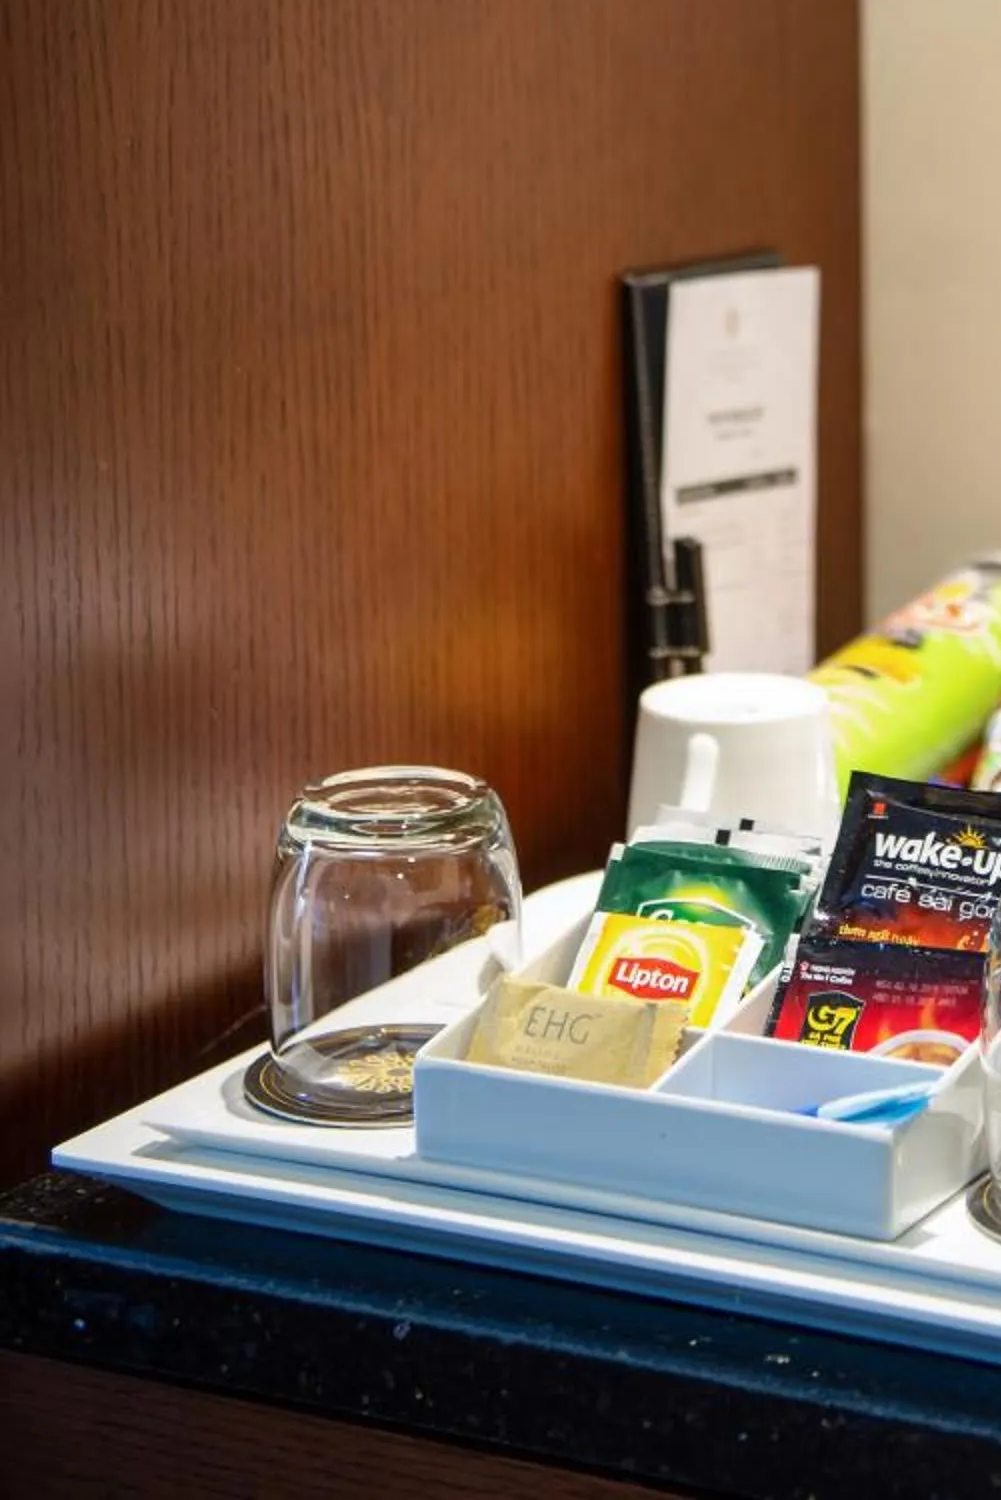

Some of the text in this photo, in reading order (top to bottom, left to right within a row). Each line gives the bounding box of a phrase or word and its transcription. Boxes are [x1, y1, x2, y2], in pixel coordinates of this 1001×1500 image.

[615, 961, 689, 993] Lipton
[523, 1006, 594, 1045] EHG
[807, 1005, 857, 1035] G7
